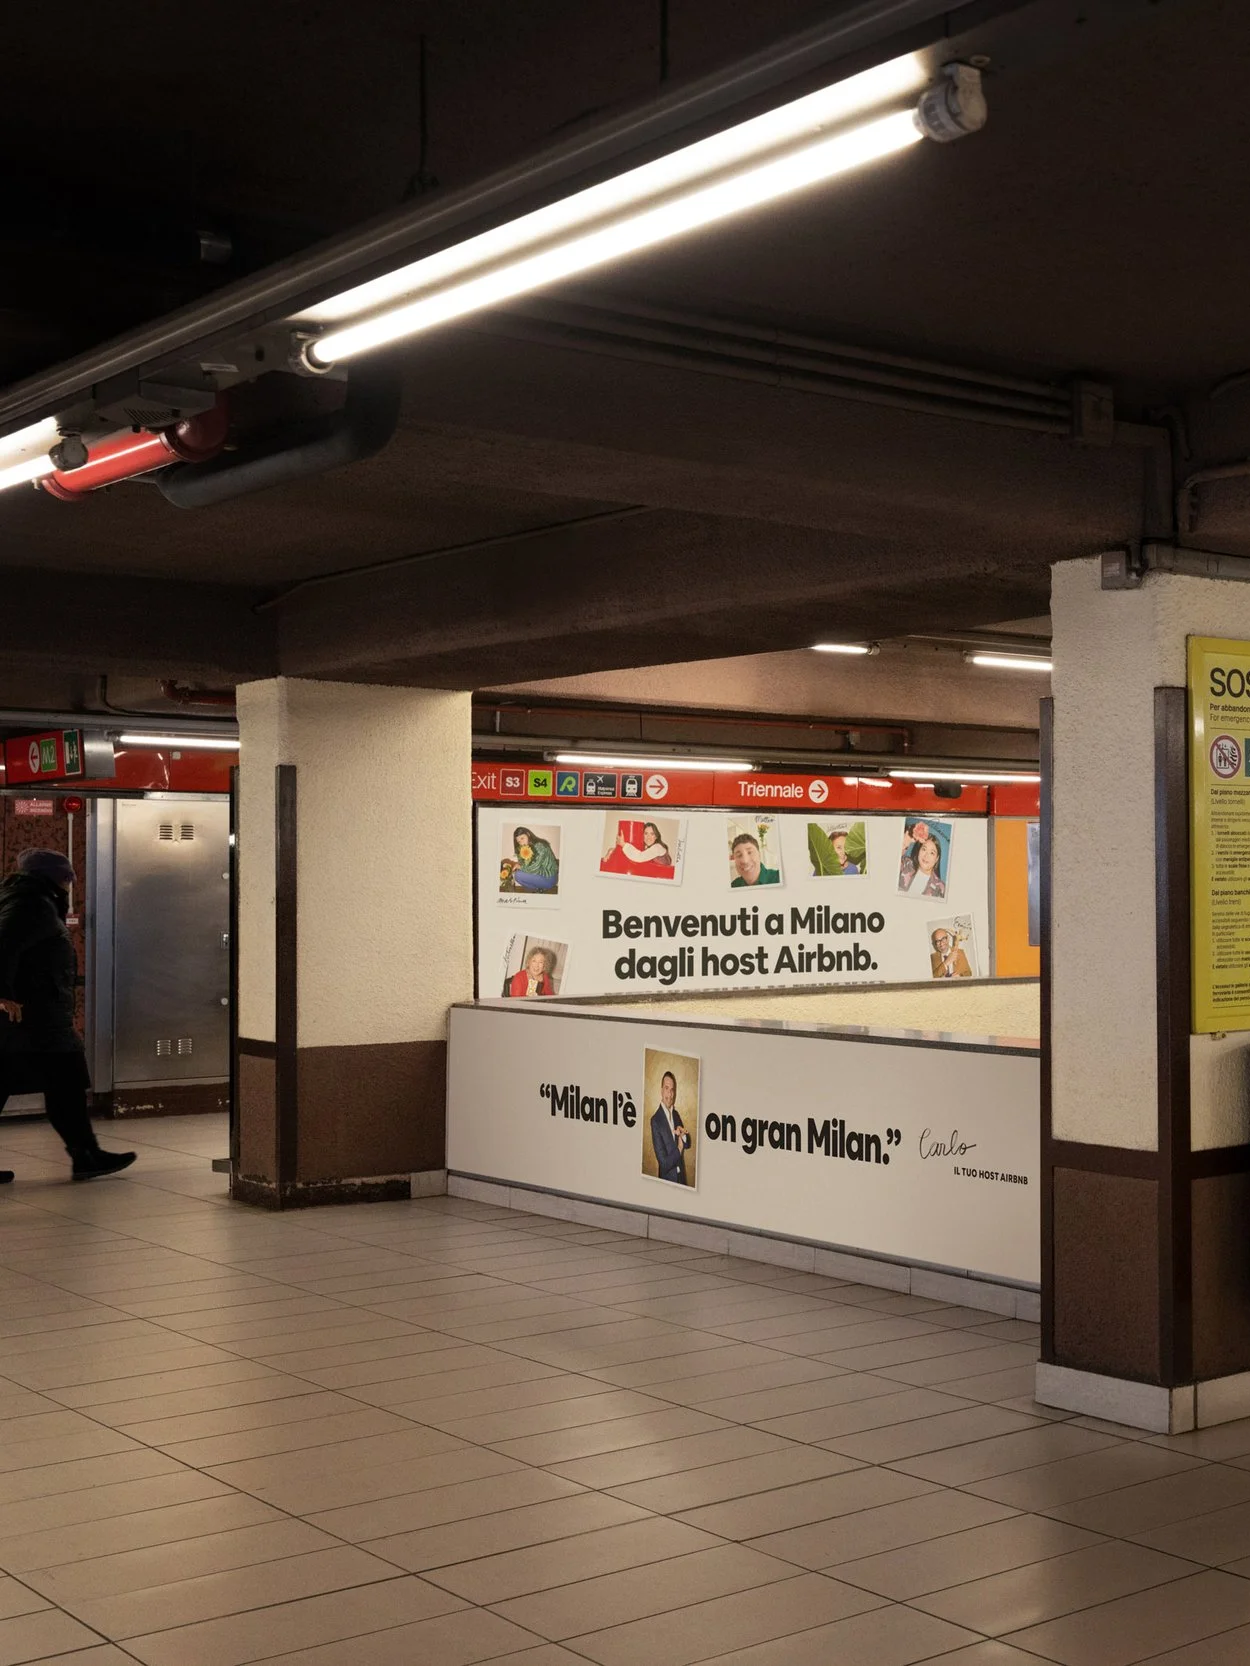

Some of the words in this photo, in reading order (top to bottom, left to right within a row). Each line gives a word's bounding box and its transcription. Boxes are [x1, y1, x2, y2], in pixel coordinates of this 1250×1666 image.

[42, 745, 55, 764] M2
[505, 777, 520, 787] S3
[533, 777, 547, 788] S4
[738, 781, 803, 798] Triennale
[602, 906, 759, 939] Benvenuti
[765, 913, 784, 936] a
[790, 905, 885, 935] Milano
[614, 946, 694, 985] dagli
[701, 946, 769, 976] host
[773, 942, 878, 974] Airbnb.
[539, 1083, 608, 1124] “Milan
[612, 1090, 637, 1128] l’è
[705, 1112, 736, 1143] on
[741, 1117, 802, 1155] gran
[807, 1117, 902, 1165] Milan.”
[919, 1128, 977, 1159] Carlo
[954, 1166, 960, 1175] IL
[961, 1167, 978, 1178] TUO
[979, 1170, 999, 1180] HOST
[1000, 1173, 1028, 1185] AIRBNB
